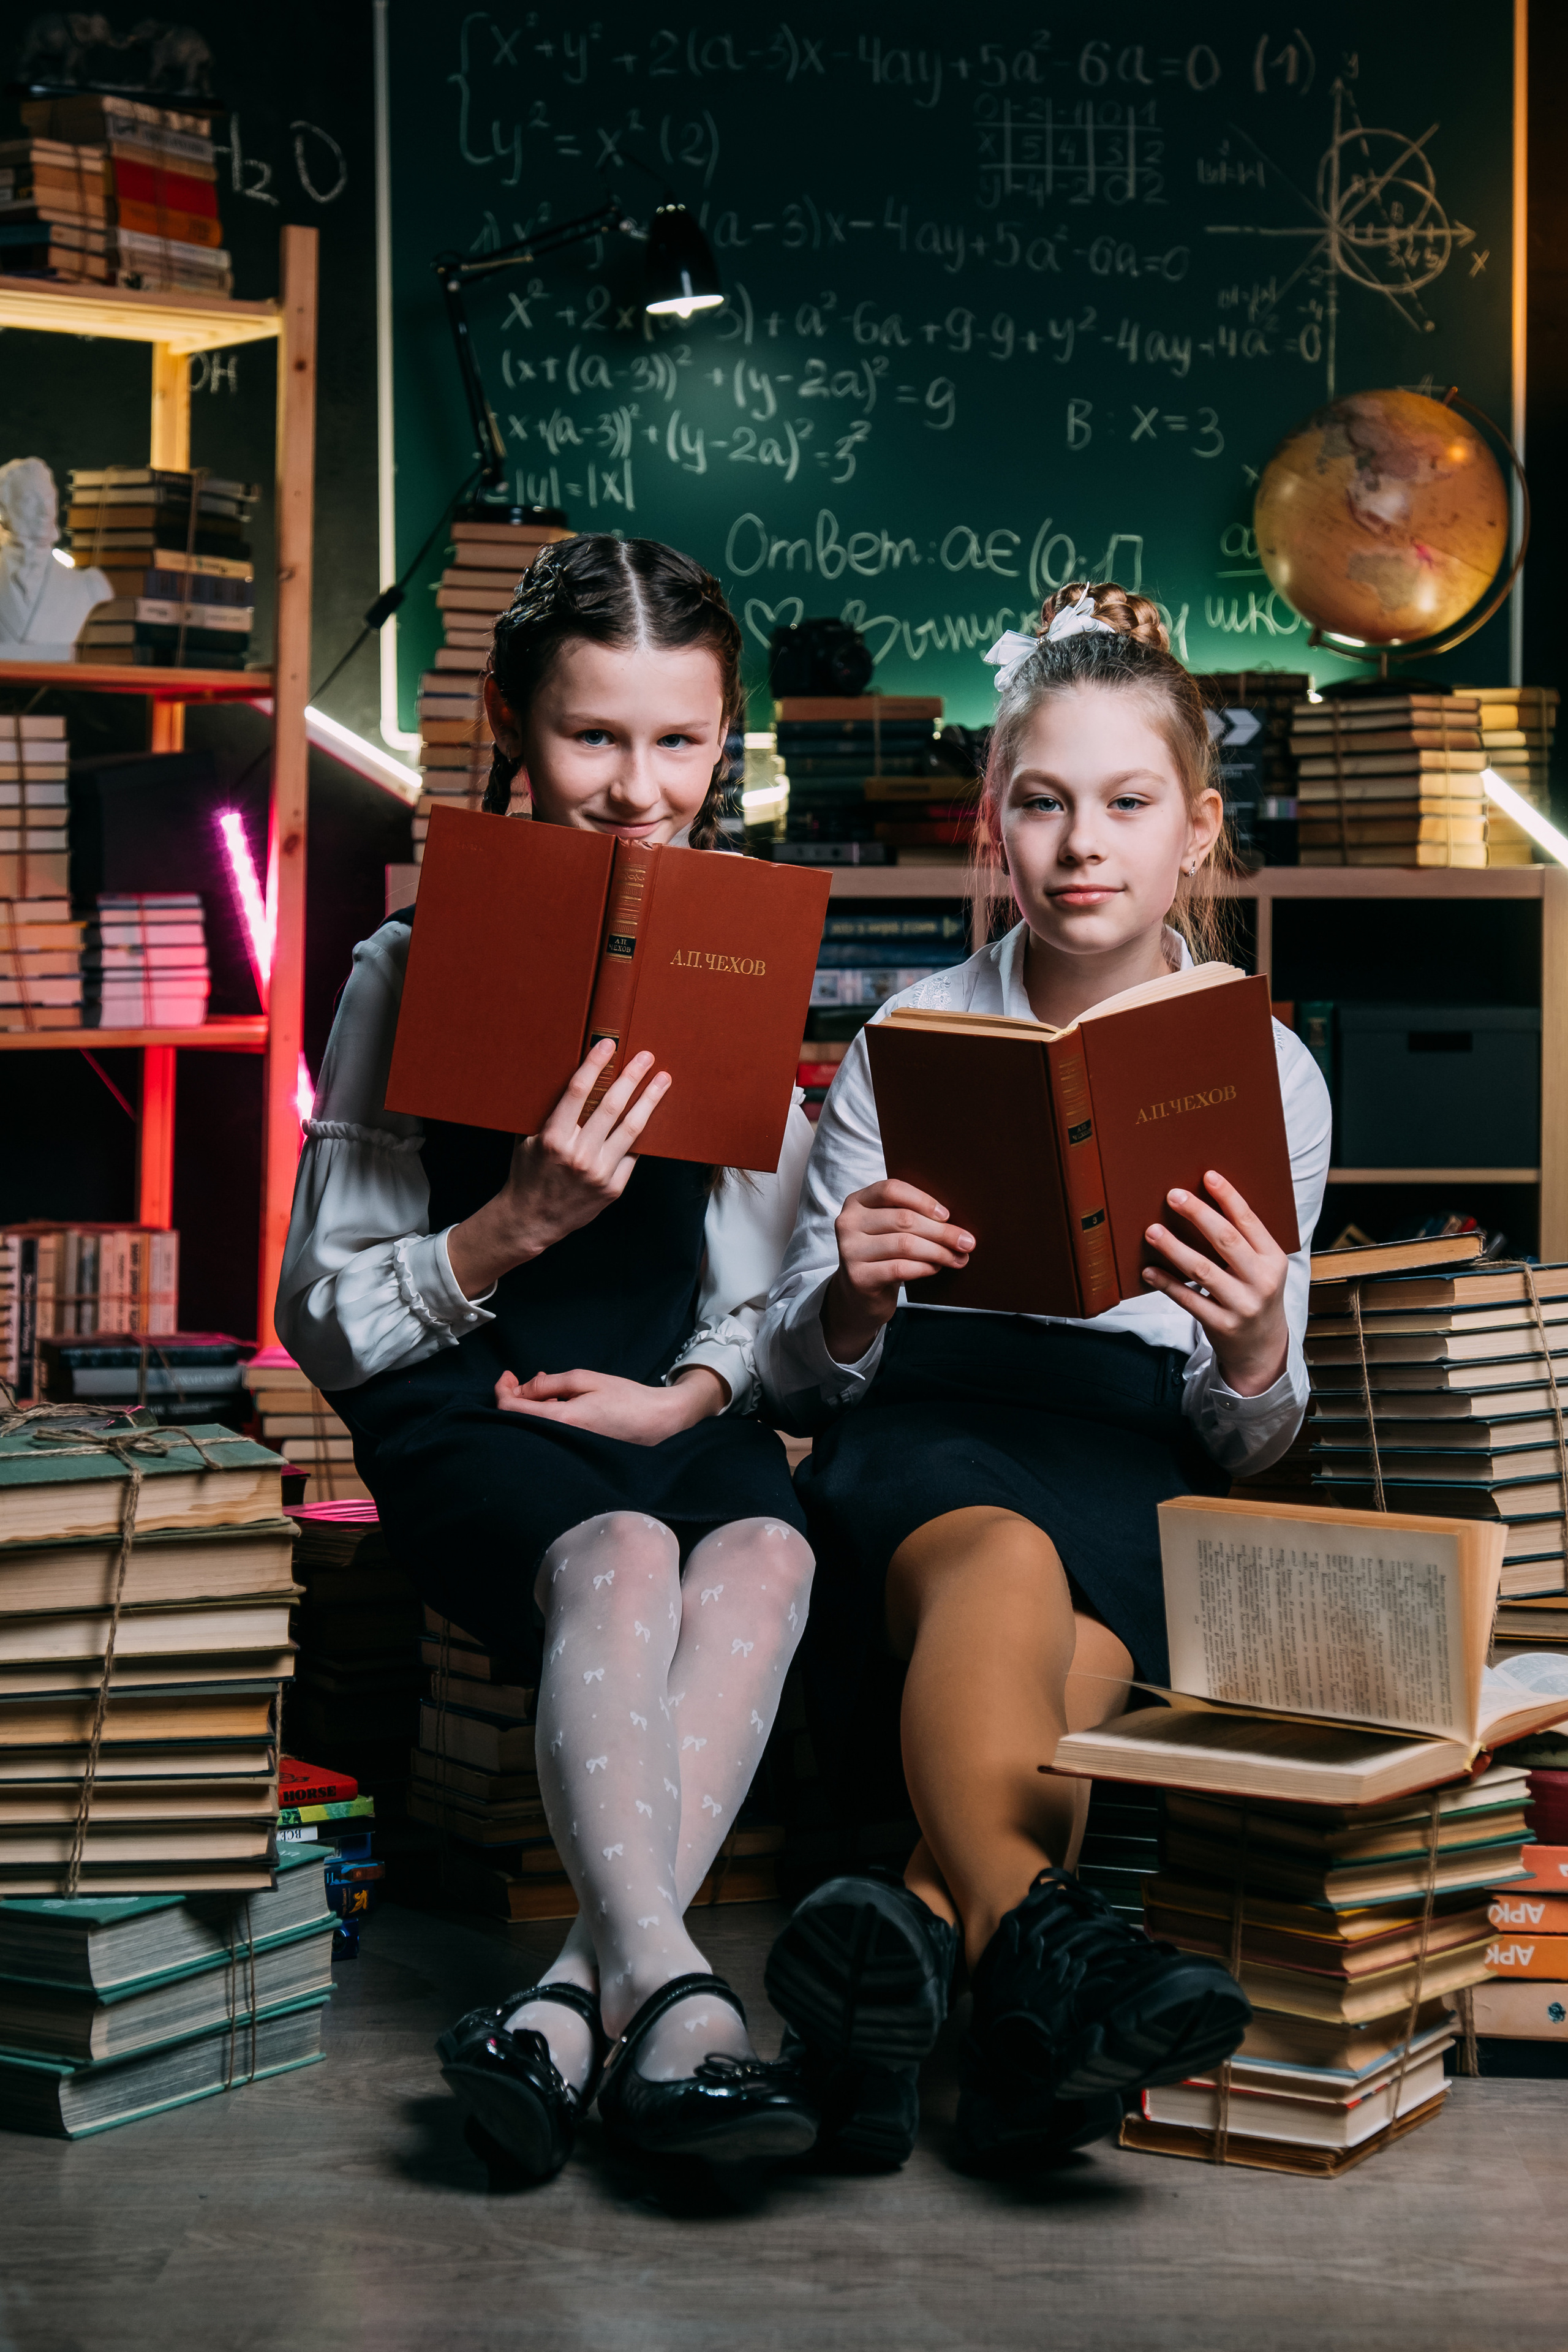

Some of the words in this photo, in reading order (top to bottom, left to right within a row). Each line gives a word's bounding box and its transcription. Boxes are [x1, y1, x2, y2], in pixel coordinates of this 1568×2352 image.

[704, 952, 767, 976] ЧЕХОВ
[1169, 1085, 1237, 1114] ЧЕХОВ
[283, 1785, 337, 1803] HORSE
